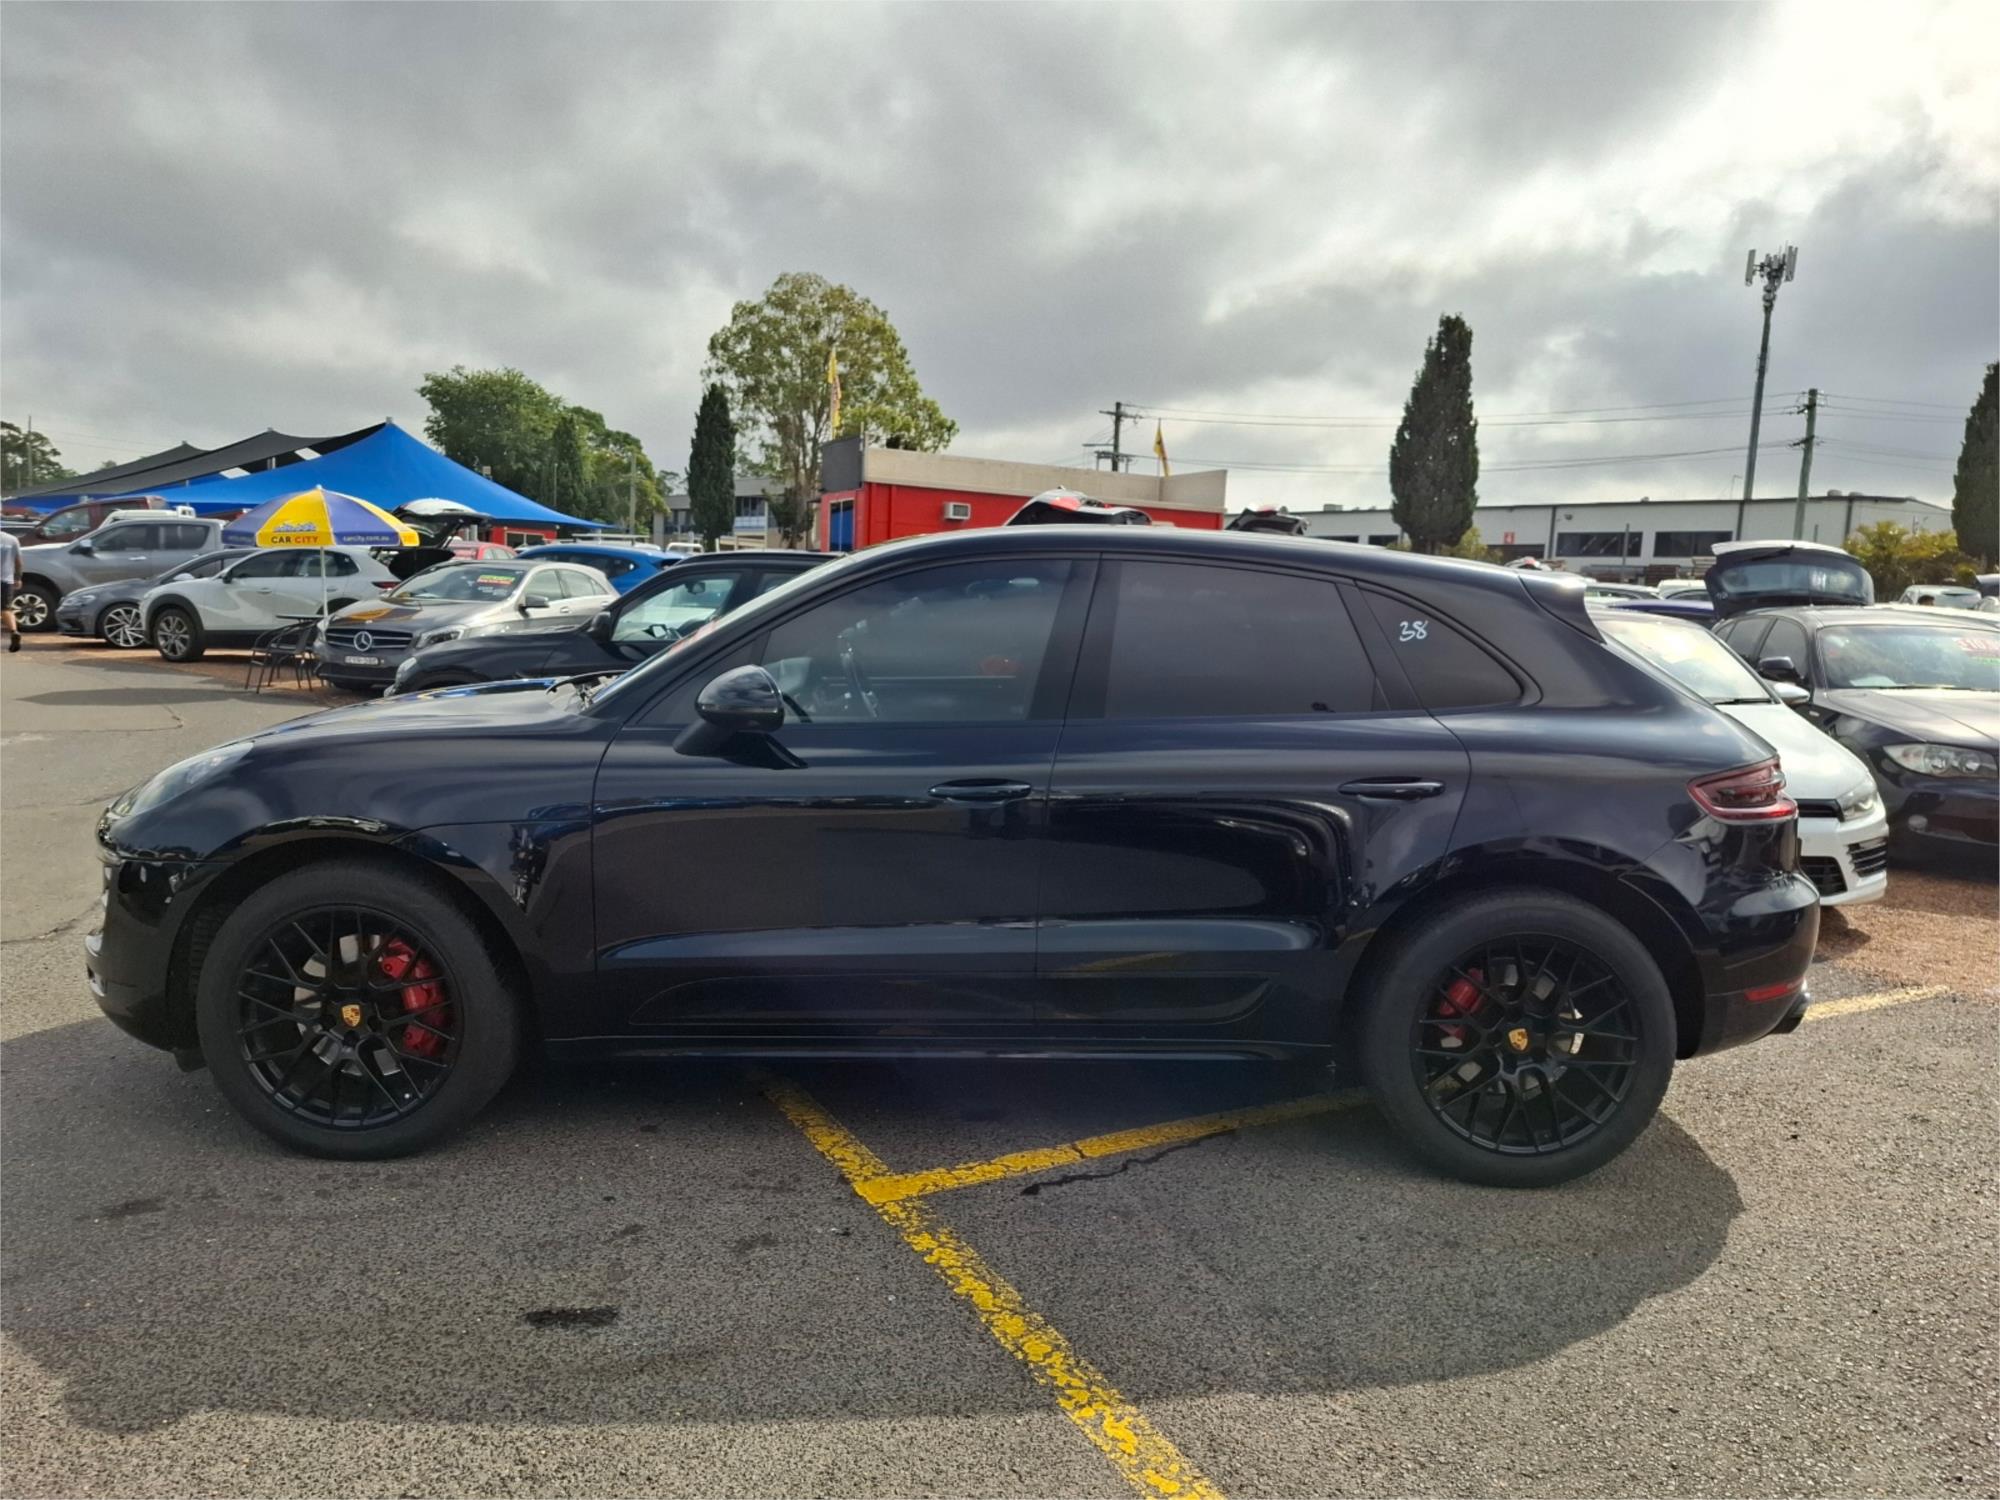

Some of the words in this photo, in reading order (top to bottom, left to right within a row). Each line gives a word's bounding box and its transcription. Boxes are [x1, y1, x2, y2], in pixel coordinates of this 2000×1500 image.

[271, 536, 291, 544] CAR
[294, 536, 319, 544] CITY
[1399, 620, 1429, 642] 38
